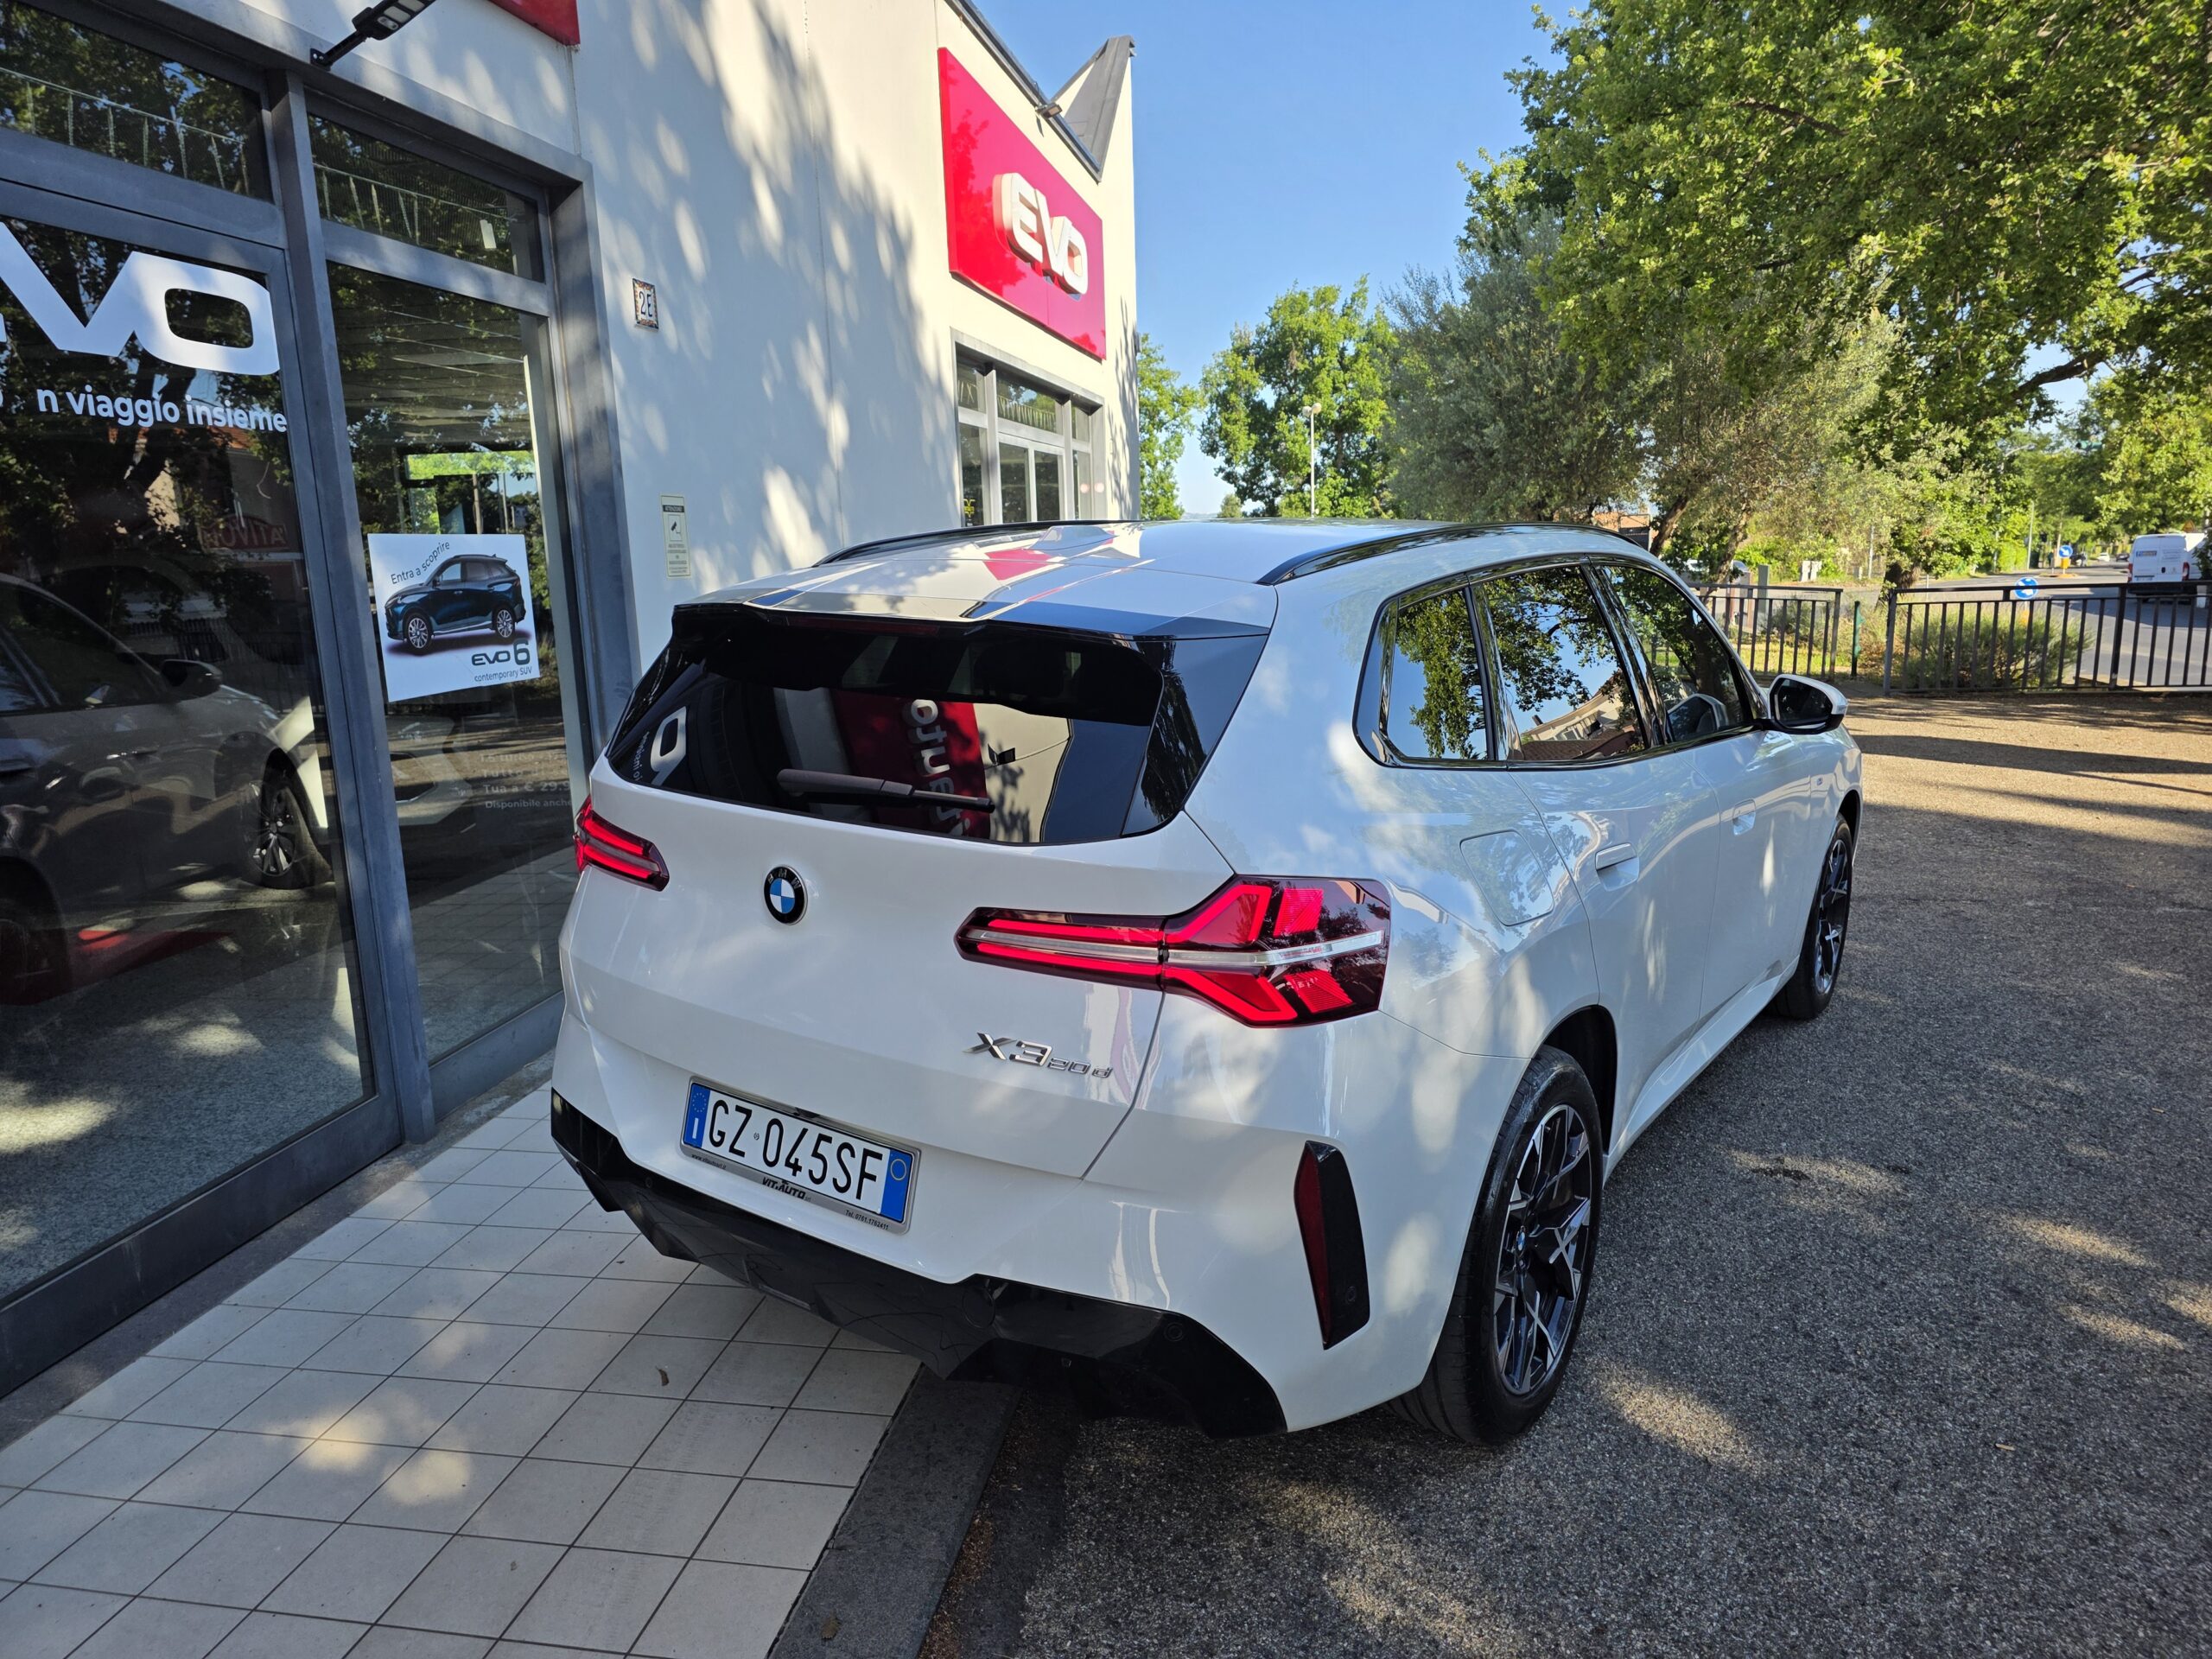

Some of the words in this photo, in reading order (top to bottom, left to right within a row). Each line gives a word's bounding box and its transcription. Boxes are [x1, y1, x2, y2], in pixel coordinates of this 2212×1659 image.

[1000, 172, 1088, 295] EVO
[0, 221, 280, 376] VO
[639, 290, 653, 318] 2E
[66, 384, 180, 429] viaggio
[185, 394, 288, 433] insieme
[391, 567, 415, 585] Entra
[415, 567, 422, 576] a
[422, 542, 450, 572] scoprire
[471, 650, 511, 667] EVO
[513, 638, 531, 665] 6
[474, 669, 518, 683] contemporary
[520, 666, 532, 677] SUV
[483, 785, 506, 794] Tua
[524, 781, 534, 792] €
[485, 798, 540, 810] Disponibile
[767, 868, 802, 890] BMW
[963, 1032, 1053, 1066] X3
[1047, 1057, 1113, 1078] 20d
